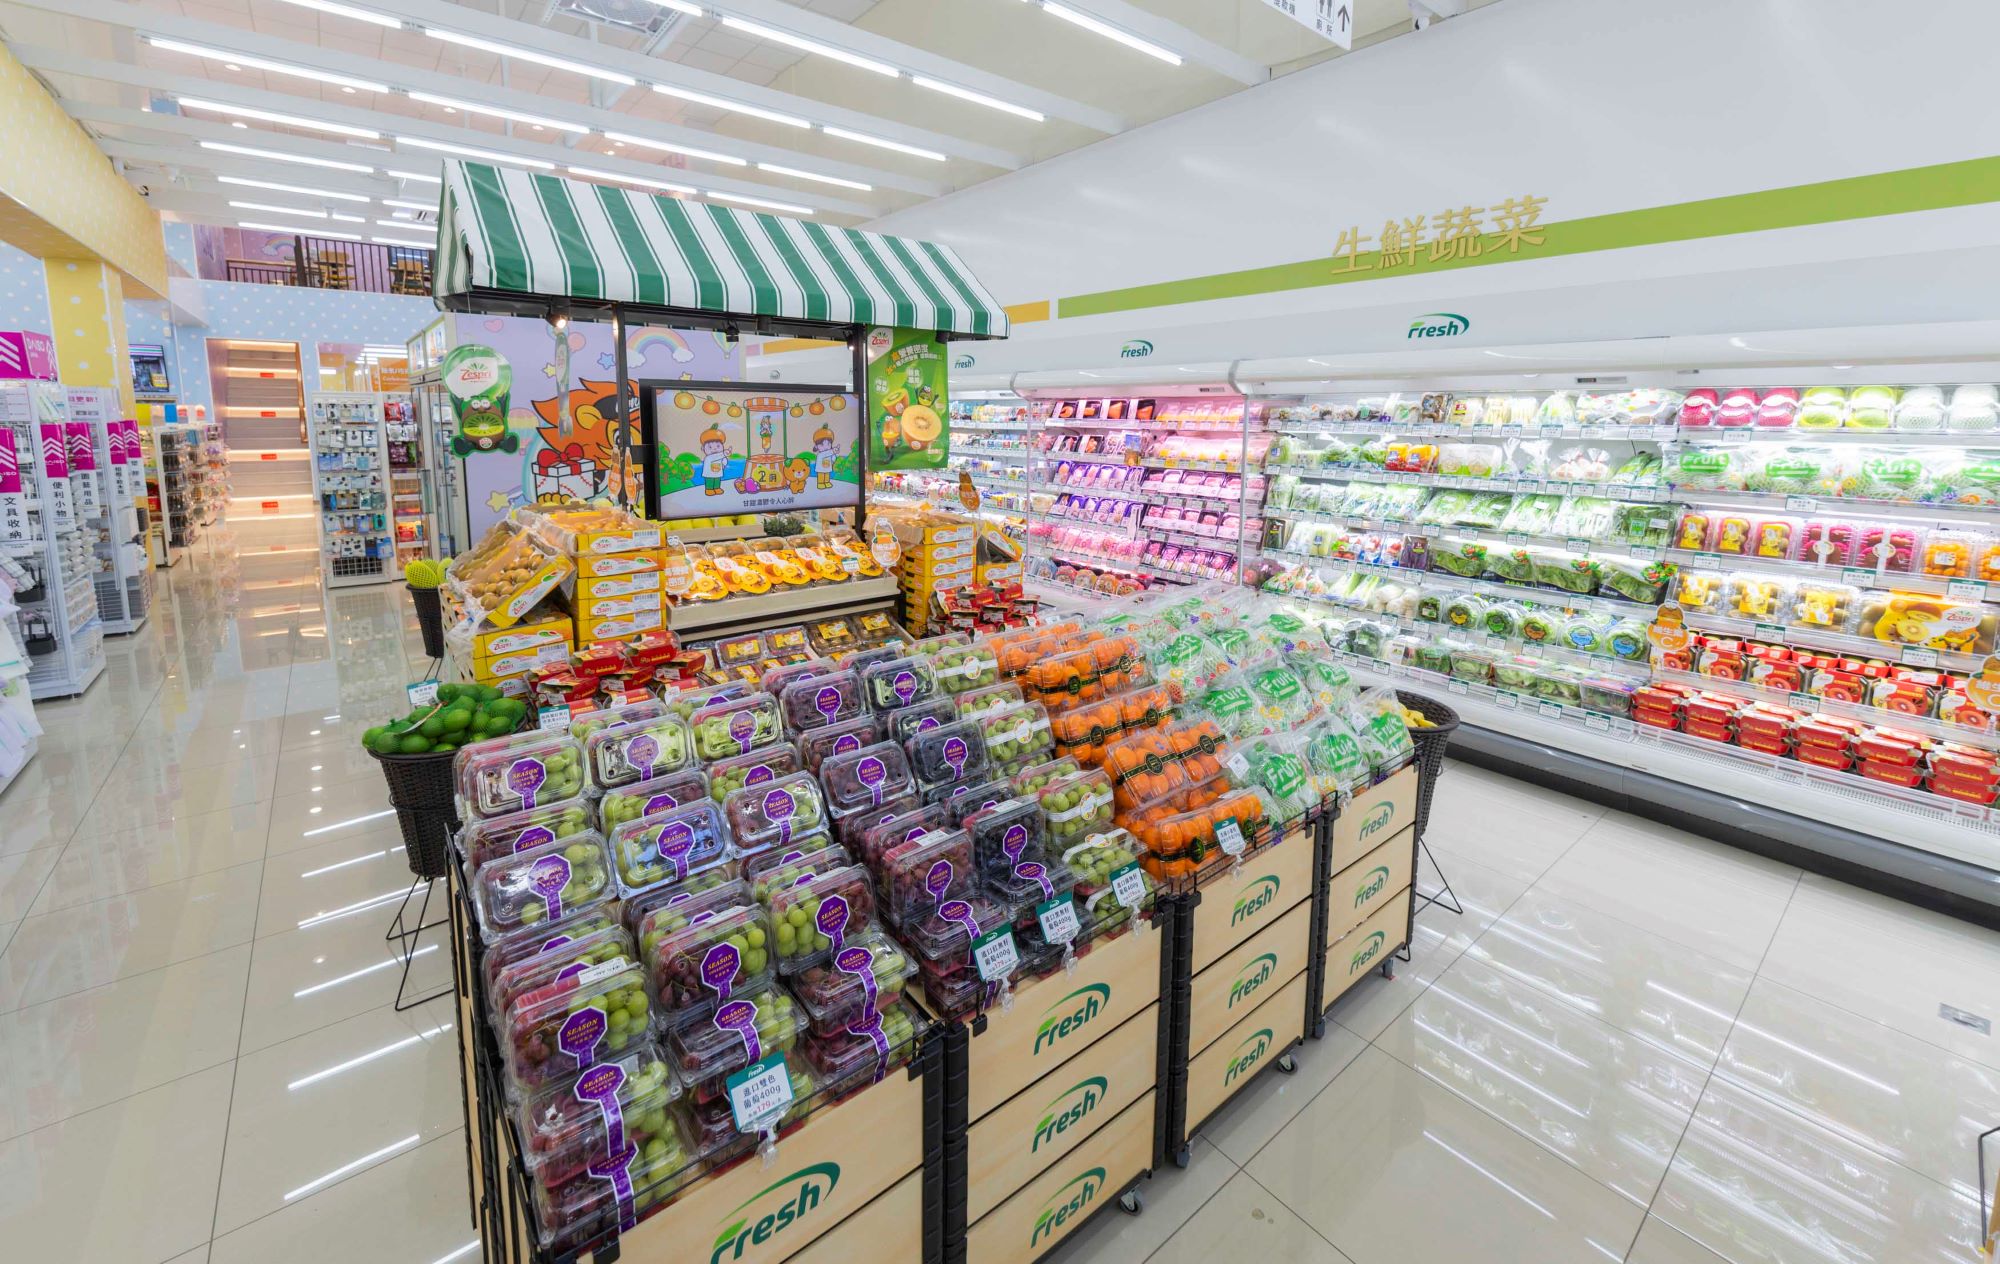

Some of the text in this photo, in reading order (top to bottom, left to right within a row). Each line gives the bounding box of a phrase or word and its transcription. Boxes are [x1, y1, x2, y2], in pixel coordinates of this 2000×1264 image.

[1331, 195, 1548, 274] 生鮮蔬菜
[1408, 319, 1460, 338] Fresh
[1121, 344, 1149, 358] Fresh
[460, 369, 492, 382] Zespri
[52, 481, 67, 517] 便利小物
[4, 497, 22, 539] 文具收納
[512, 767, 539, 779] SEASON
[768, 798, 789, 808] SEASON
[663, 832, 687, 844] SEASON
[1358, 812, 1389, 841] Fresh
[520, 836, 548, 849] SEASON
[1354, 876, 1384, 909] Fresh
[821, 905, 843, 920] SEASON
[1231, 883, 1273, 928] Fresh
[707, 953, 733, 969] SEASON
[842, 951, 864, 965] SEASON
[1350, 940, 1380, 976] Fresh
[1228, 962, 1270, 1009] Fresh
[721, 1005, 747, 1022] SEASON
[1033, 994, 1099, 1056] Fresh
[567, 1018, 598, 1037] SEASON
[1224, 1038, 1266, 1088] Fresh
[583, 1070, 615, 1088] SEASON
[743, 1074, 776, 1098] 進口雙色
[743, 1084, 781, 1109] 葡萄400g
[757, 1101, 771, 1113] 179
[1031, 1088, 1097, 1153] Fresh
[709, 1181, 822, 1264] Fresh
[1030, 1178, 1096, 1249] Fresh
